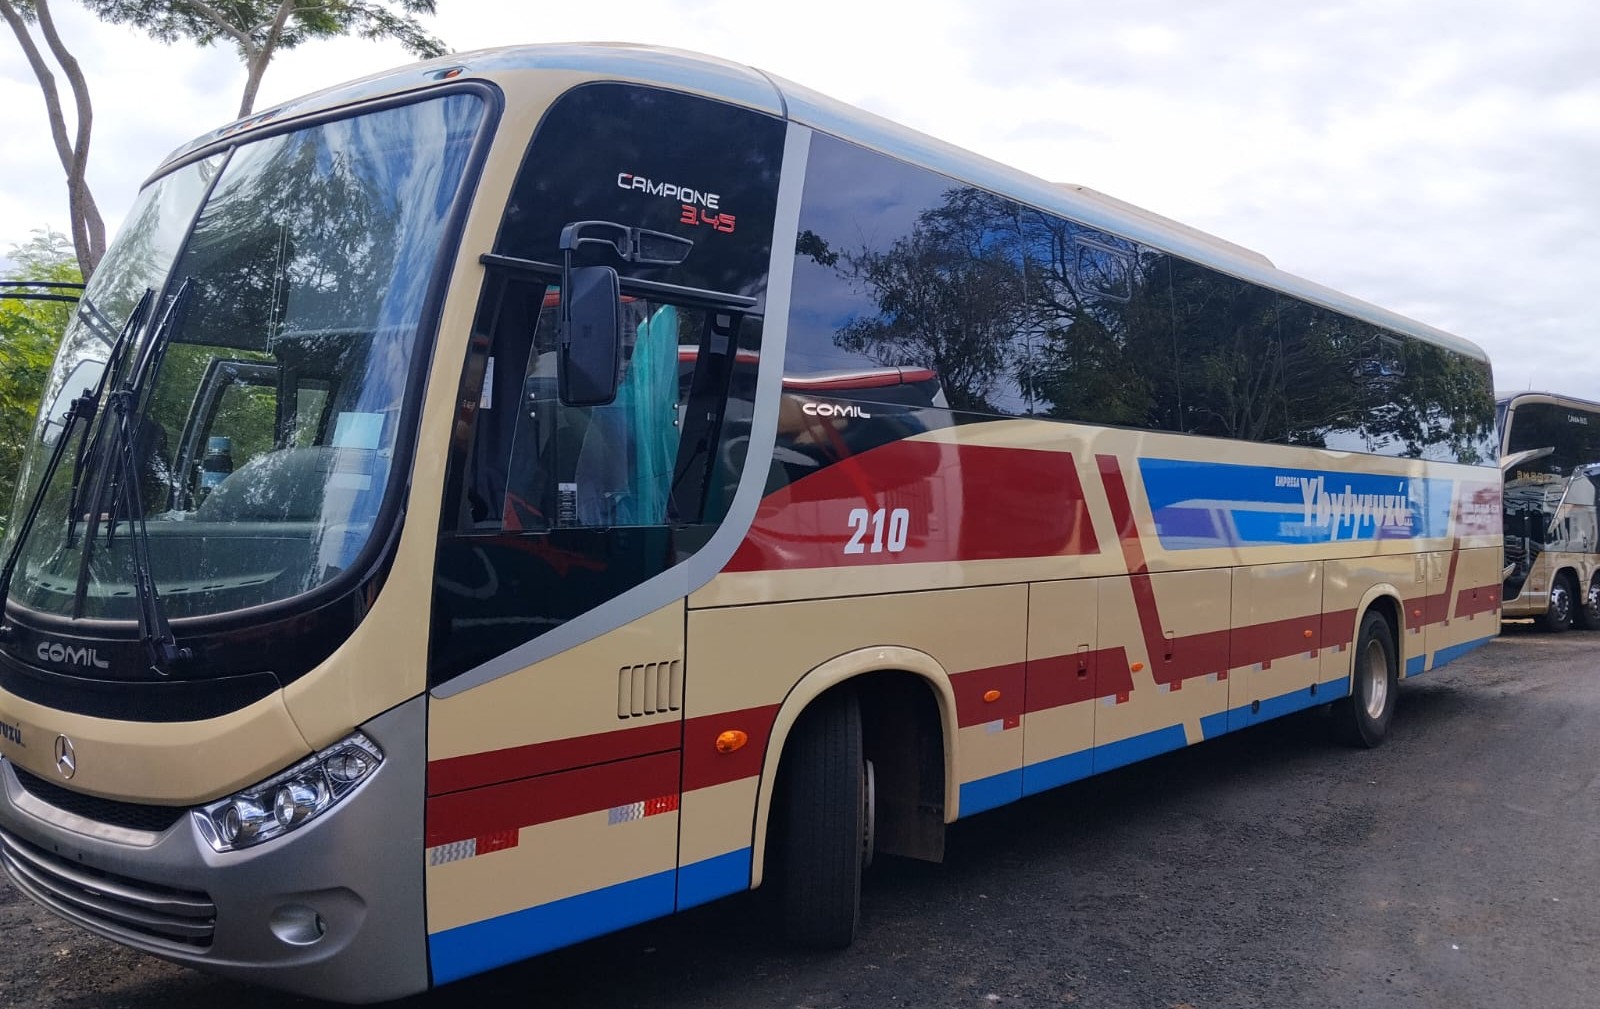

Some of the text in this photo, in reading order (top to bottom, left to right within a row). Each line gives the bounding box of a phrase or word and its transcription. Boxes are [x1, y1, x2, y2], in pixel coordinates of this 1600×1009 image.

[617, 172, 720, 209] CAMPIONE
[680, 204, 736, 233] 3.45
[802, 403, 871, 419] COMIL
[844, 508, 910, 554] 210
[37, 641, 110, 669] COMIL
